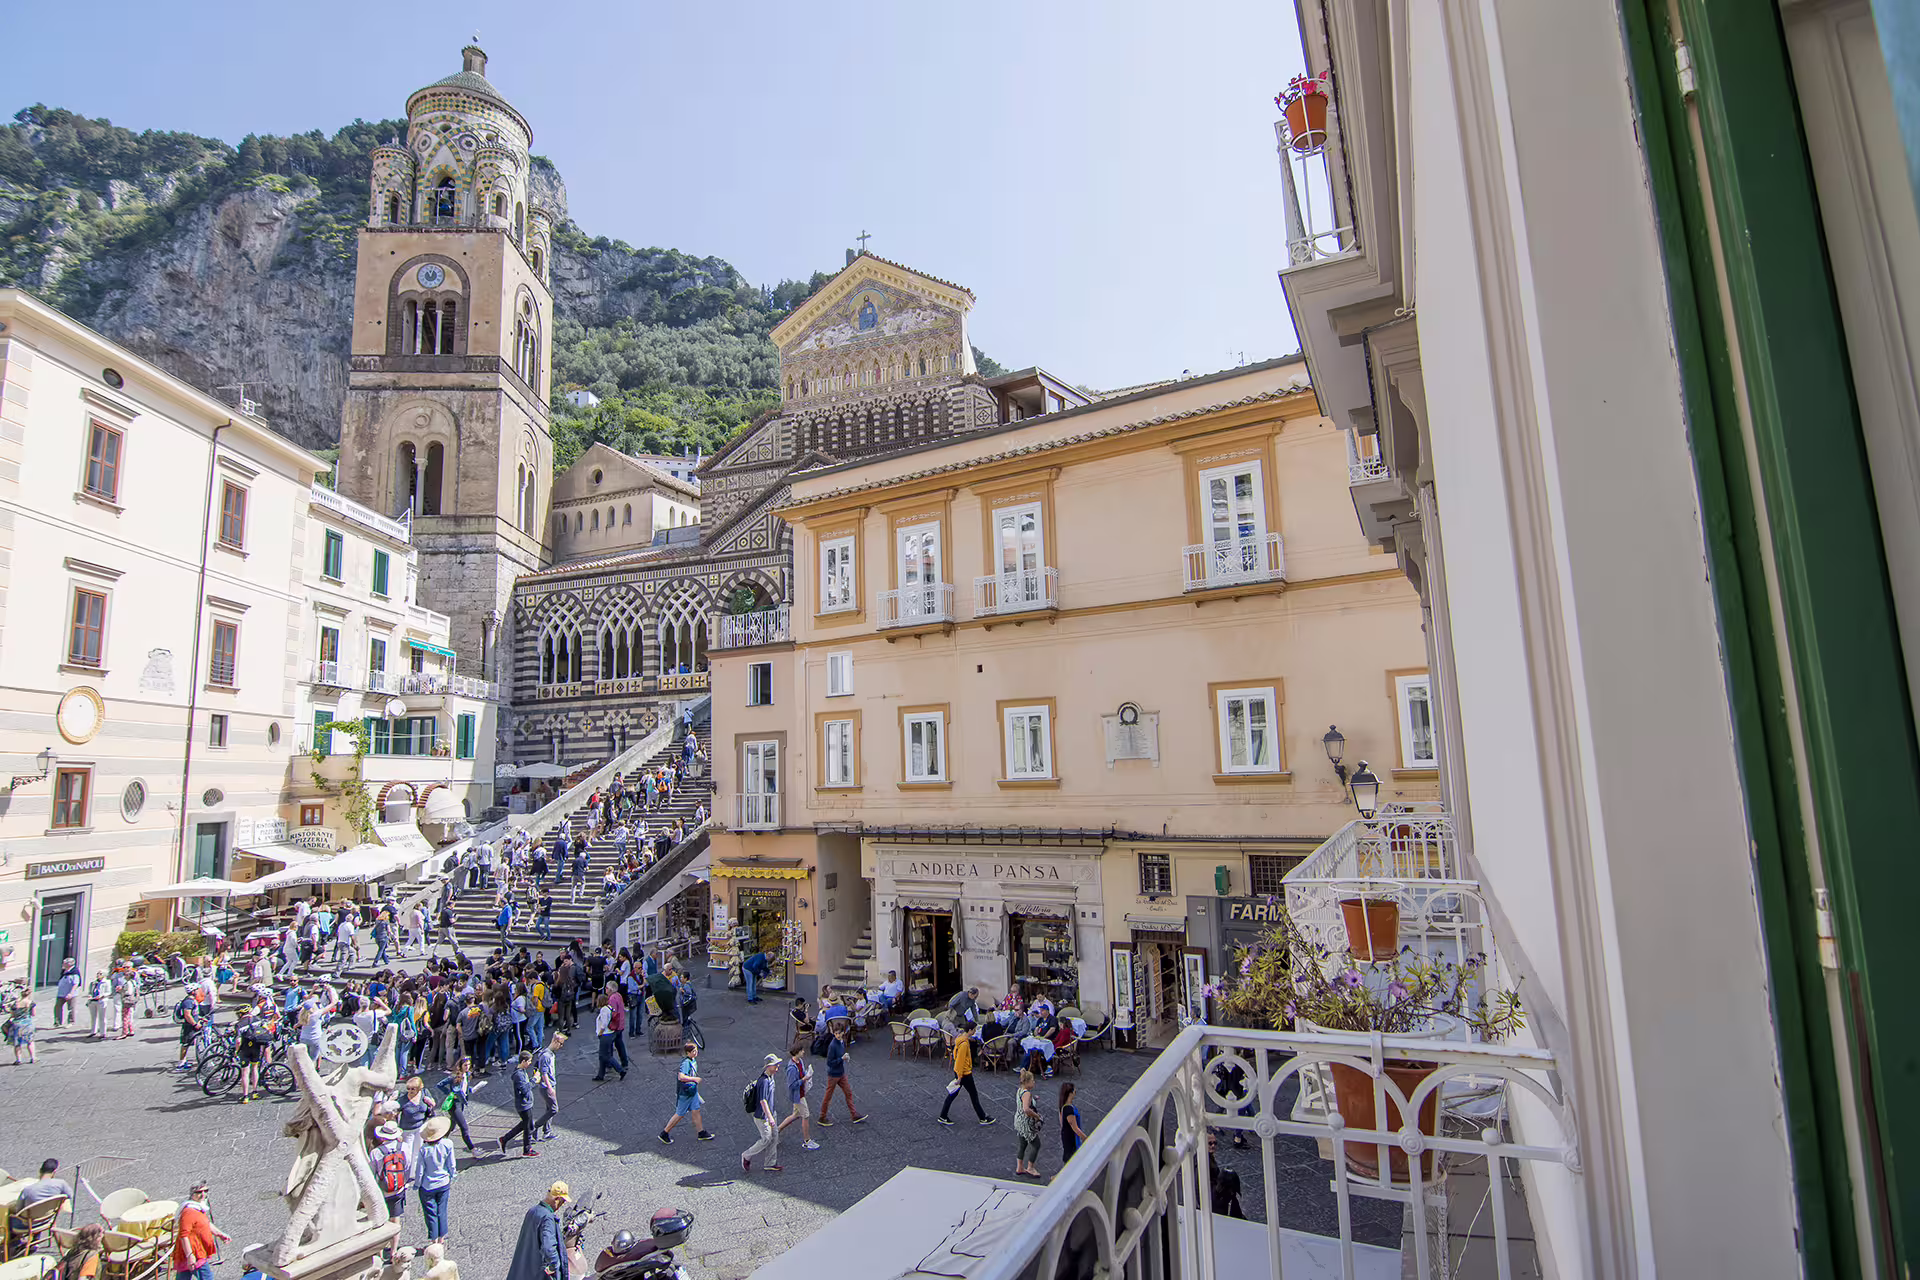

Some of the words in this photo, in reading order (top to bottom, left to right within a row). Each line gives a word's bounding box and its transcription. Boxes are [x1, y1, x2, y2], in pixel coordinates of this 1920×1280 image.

[289, 831, 334, 840] RISTORANTE
[295, 837, 329, 845] PIZZERIA
[41, 863, 69, 874] BANCO
[76, 859, 103, 870] NAPOLI
[909, 862, 979, 877] ANDREA
[994, 864, 1060, 880] PANSA
[906, 899, 939, 907] Pasticceria
[1014, 903, 1052, 913] Caffetteria
